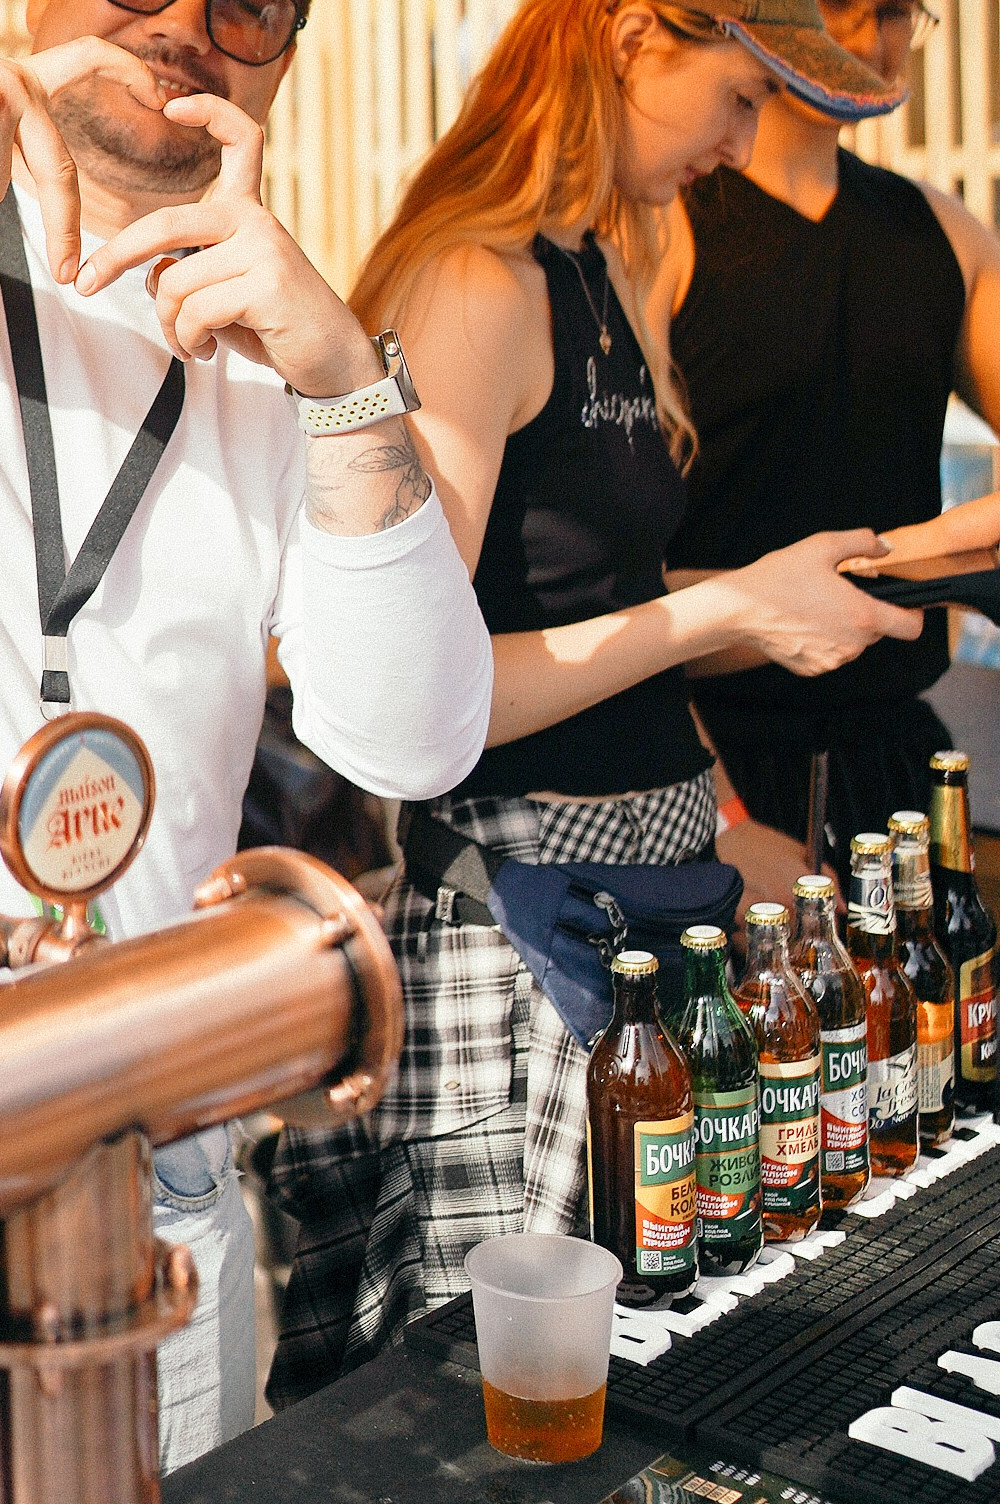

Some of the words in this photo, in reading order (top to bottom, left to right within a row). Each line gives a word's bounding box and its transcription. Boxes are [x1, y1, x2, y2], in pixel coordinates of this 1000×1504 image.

[828, 1048, 867, 1083] БОЧК
[762, 1077, 821, 1114] ОЧКАР
[777, 1121, 819, 1141] ГРИЛЬ
[646, 1136, 696, 1176] БОЧКА
[776, 1139, 819, 1156] ХМЕЛЬ
[696, 1191, 729, 1203] ИГРАЙ
[670, 1196, 696, 1217] КОЛ
[696, 1207, 729, 1216] ИЗОВ
[642, 1219, 684, 1233] ВЫИГРАЙ
[642, 1227, 691, 1241] МИЛЛИОН
[642, 1237, 684, 1248] ПРИЗОВ
